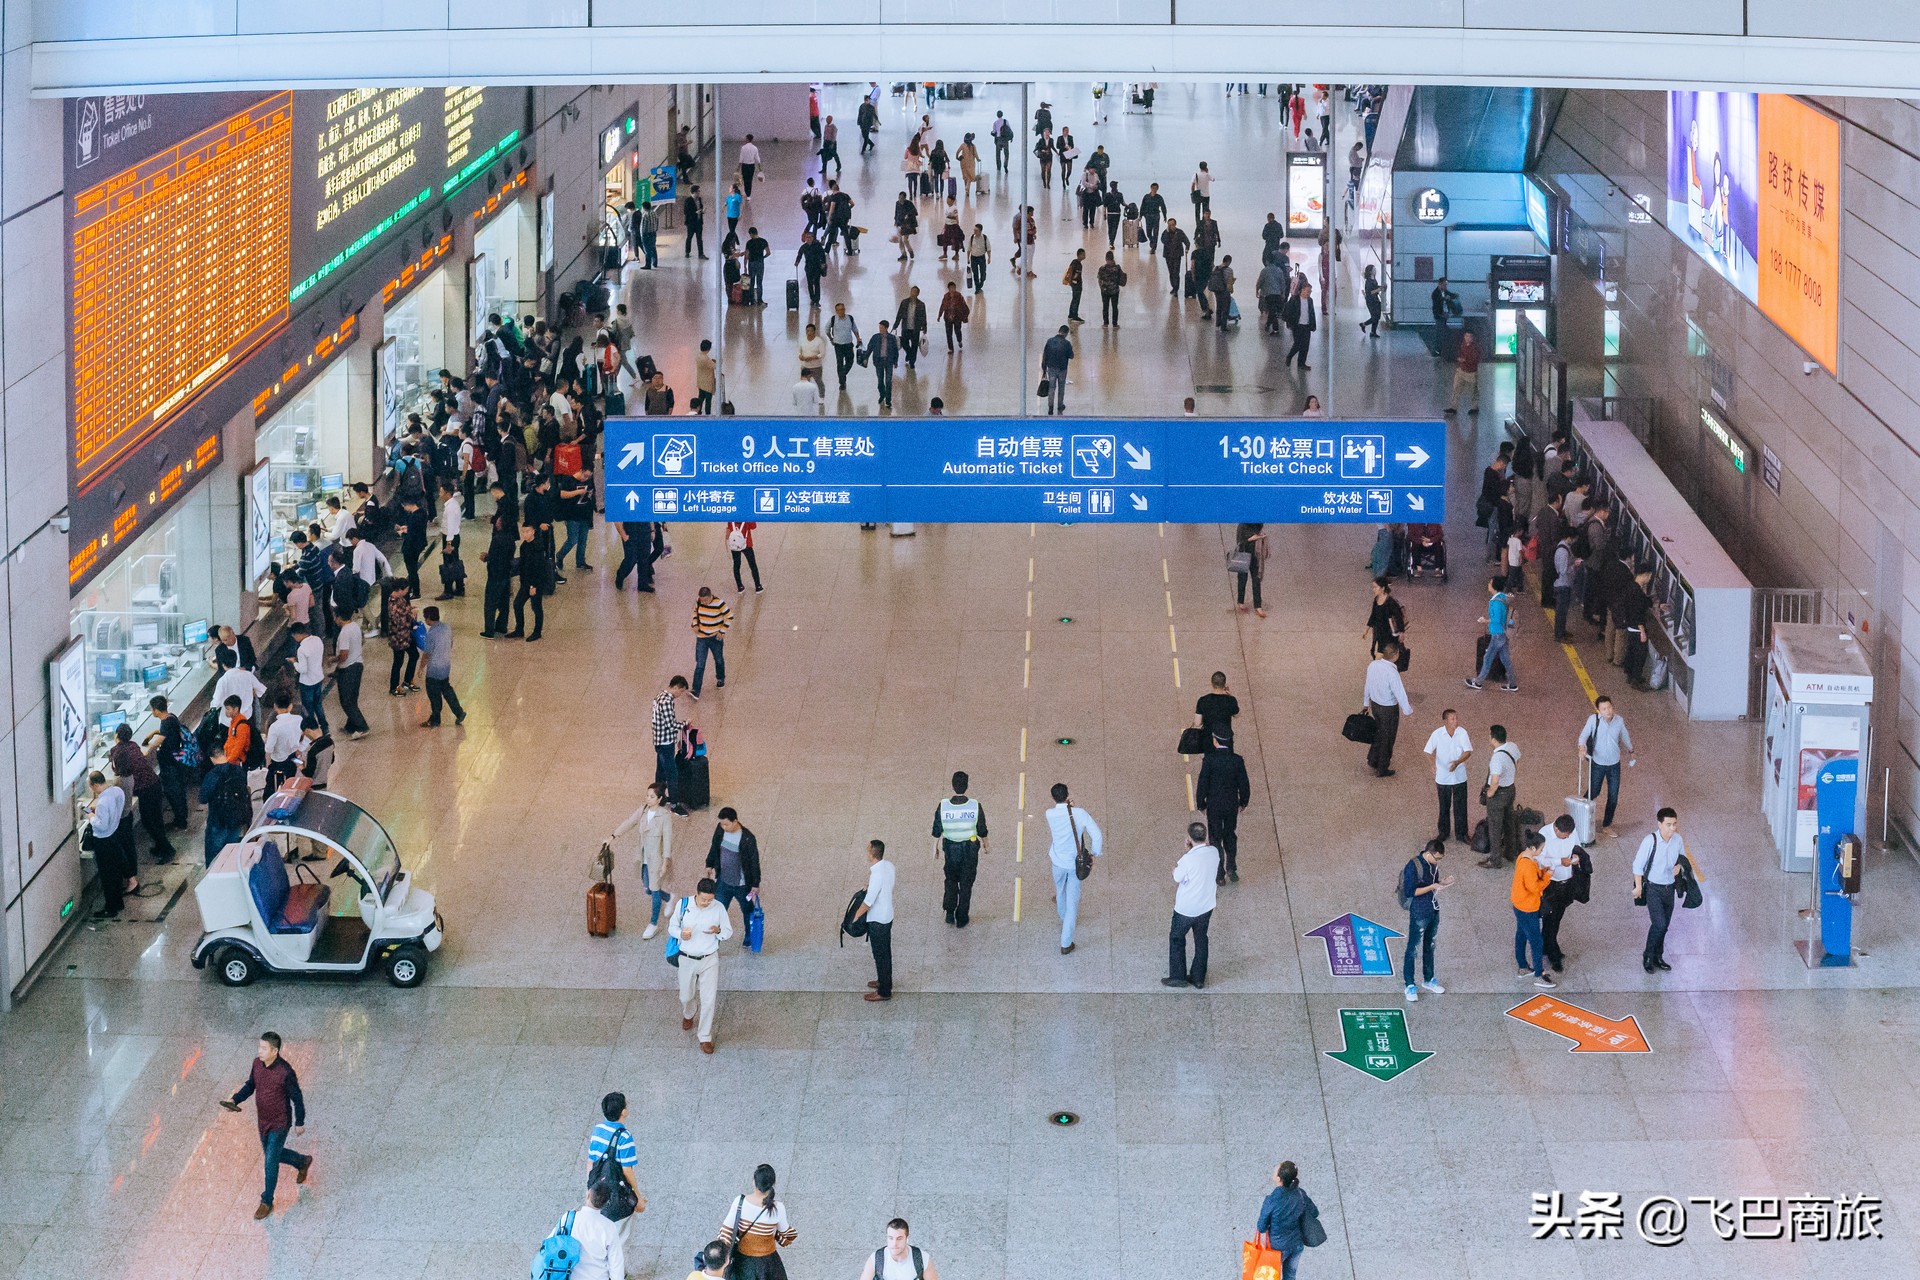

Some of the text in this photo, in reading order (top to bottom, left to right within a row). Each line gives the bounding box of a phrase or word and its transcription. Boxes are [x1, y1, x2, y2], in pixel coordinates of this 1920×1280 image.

[103, 114, 152, 149] Ticket Office No.8
[1768, 151, 1825, 222] 路铁传媒
[1770, 247, 1821, 307] 188 1777 8008
[742, 436, 875, 459] 9 人工售票处
[977, 436, 1063, 458] 自动售票
[1219, 435, 1334, 459] 1-30 检票口
[701, 462, 738, 473] Ticket
[742, 461, 779, 473] Office
[943, 462, 1063, 474] Automatic Ticket
[1240, 462, 1333, 474] Ticket Check
[683, 490, 735, 504] 小件寄存
[785, 490, 850, 504] 公安值班室
[1043, 491, 1081, 505] 卫生间
[1323, 491, 1363, 505] 饮水处
[683, 504, 737, 515] Left Luggage
[784, 505, 810, 513] Police
[1057, 505, 1081, 513] Toilet
[1301, 506, 1362, 516] Drinking Water
[1609, 1034, 1629, 1045] VIP
